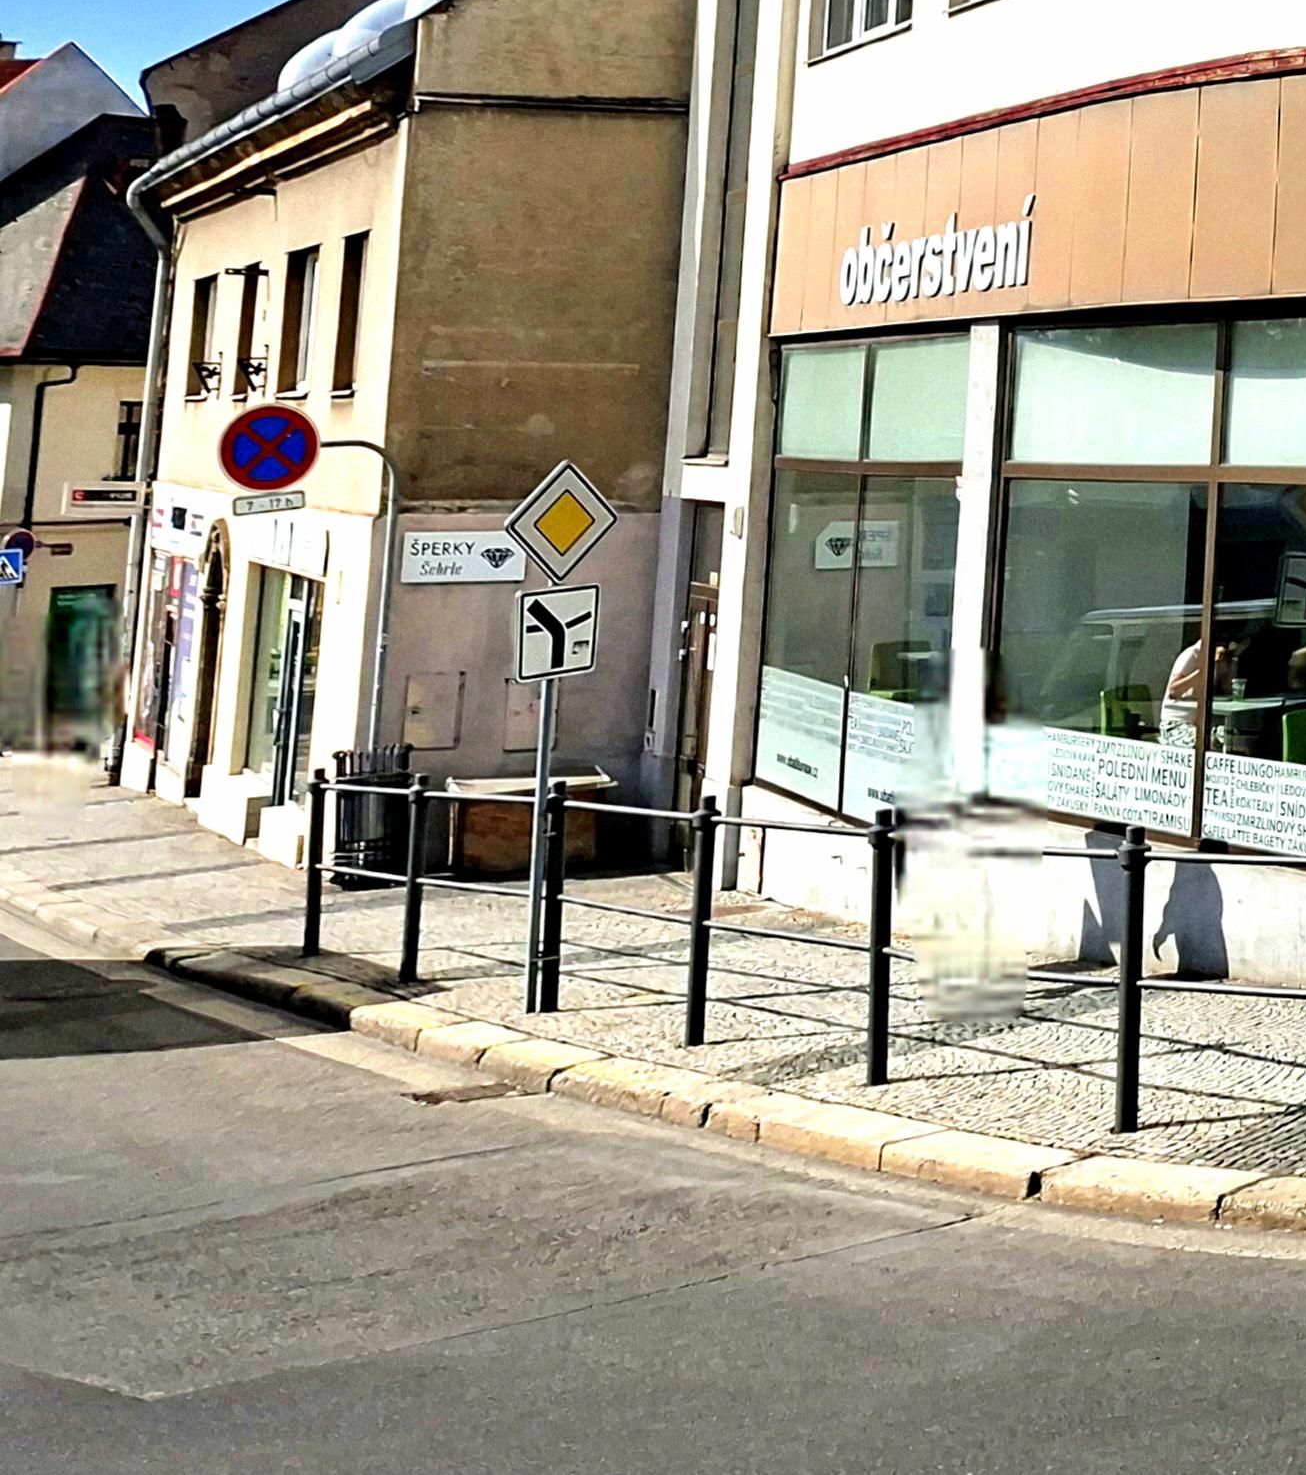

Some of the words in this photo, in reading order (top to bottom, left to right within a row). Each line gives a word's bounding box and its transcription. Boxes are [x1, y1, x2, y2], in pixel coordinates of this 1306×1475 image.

[839, 194, 1036, 305] občerstvení
[246, 501, 254, 511] 7
[269, 498, 282, 508] 17
[410, 539, 476, 557] ŠPERKY
[1161, 750, 1193, 768] SHAKE
[1206, 756, 1235, 774] CAFFE
[1238, 760, 1274, 779] LUNGO
[1151, 766, 1187, 789] MENU
[1205, 787, 1228, 808] TEA
[1252, 832, 1286, 850] BAGETY
